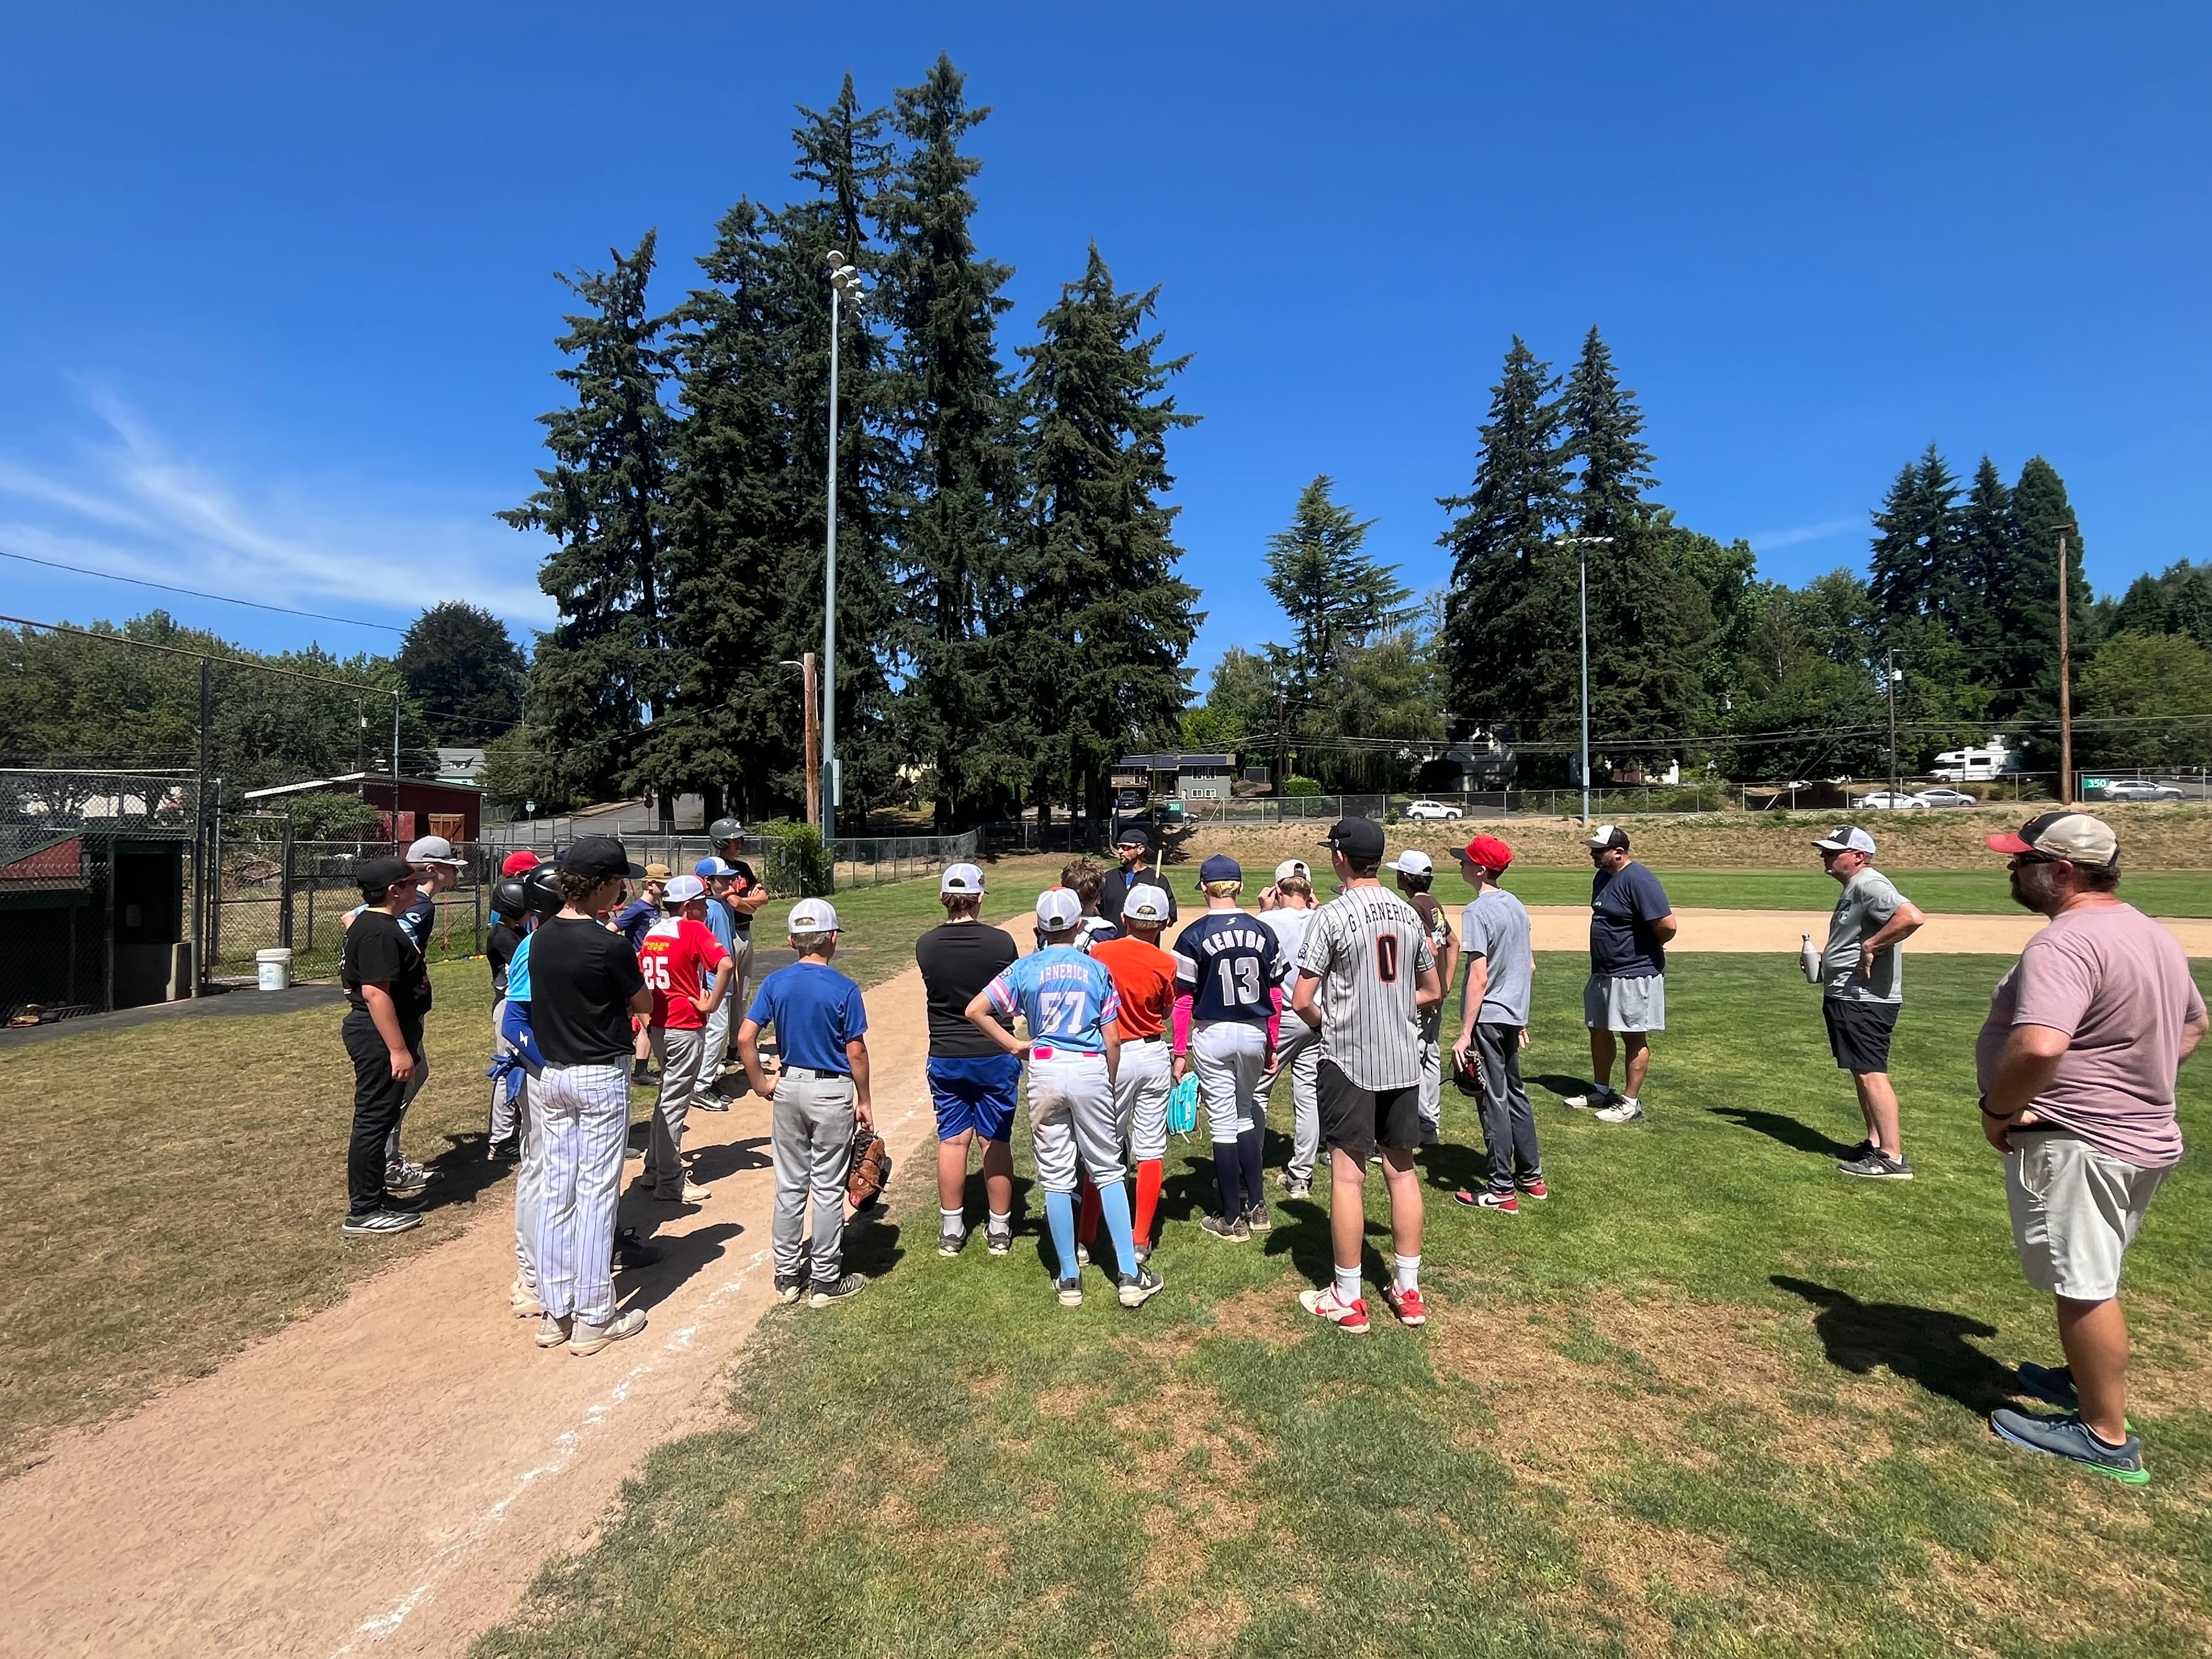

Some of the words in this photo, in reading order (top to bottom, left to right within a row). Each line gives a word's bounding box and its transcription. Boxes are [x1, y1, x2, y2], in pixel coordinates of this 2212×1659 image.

[2088, 779, 2107, 787] 350
[1348, 914, 1361, 933] G.
[1202, 929, 1266, 956] KENYON
[642, 956, 671, 990] 25
[1376, 934, 1397, 983] 0
[1039, 964, 1089, 986] ARNERICH
[1218, 957, 1260, 1006] 13
[1040, 991, 1086, 1033] 57
